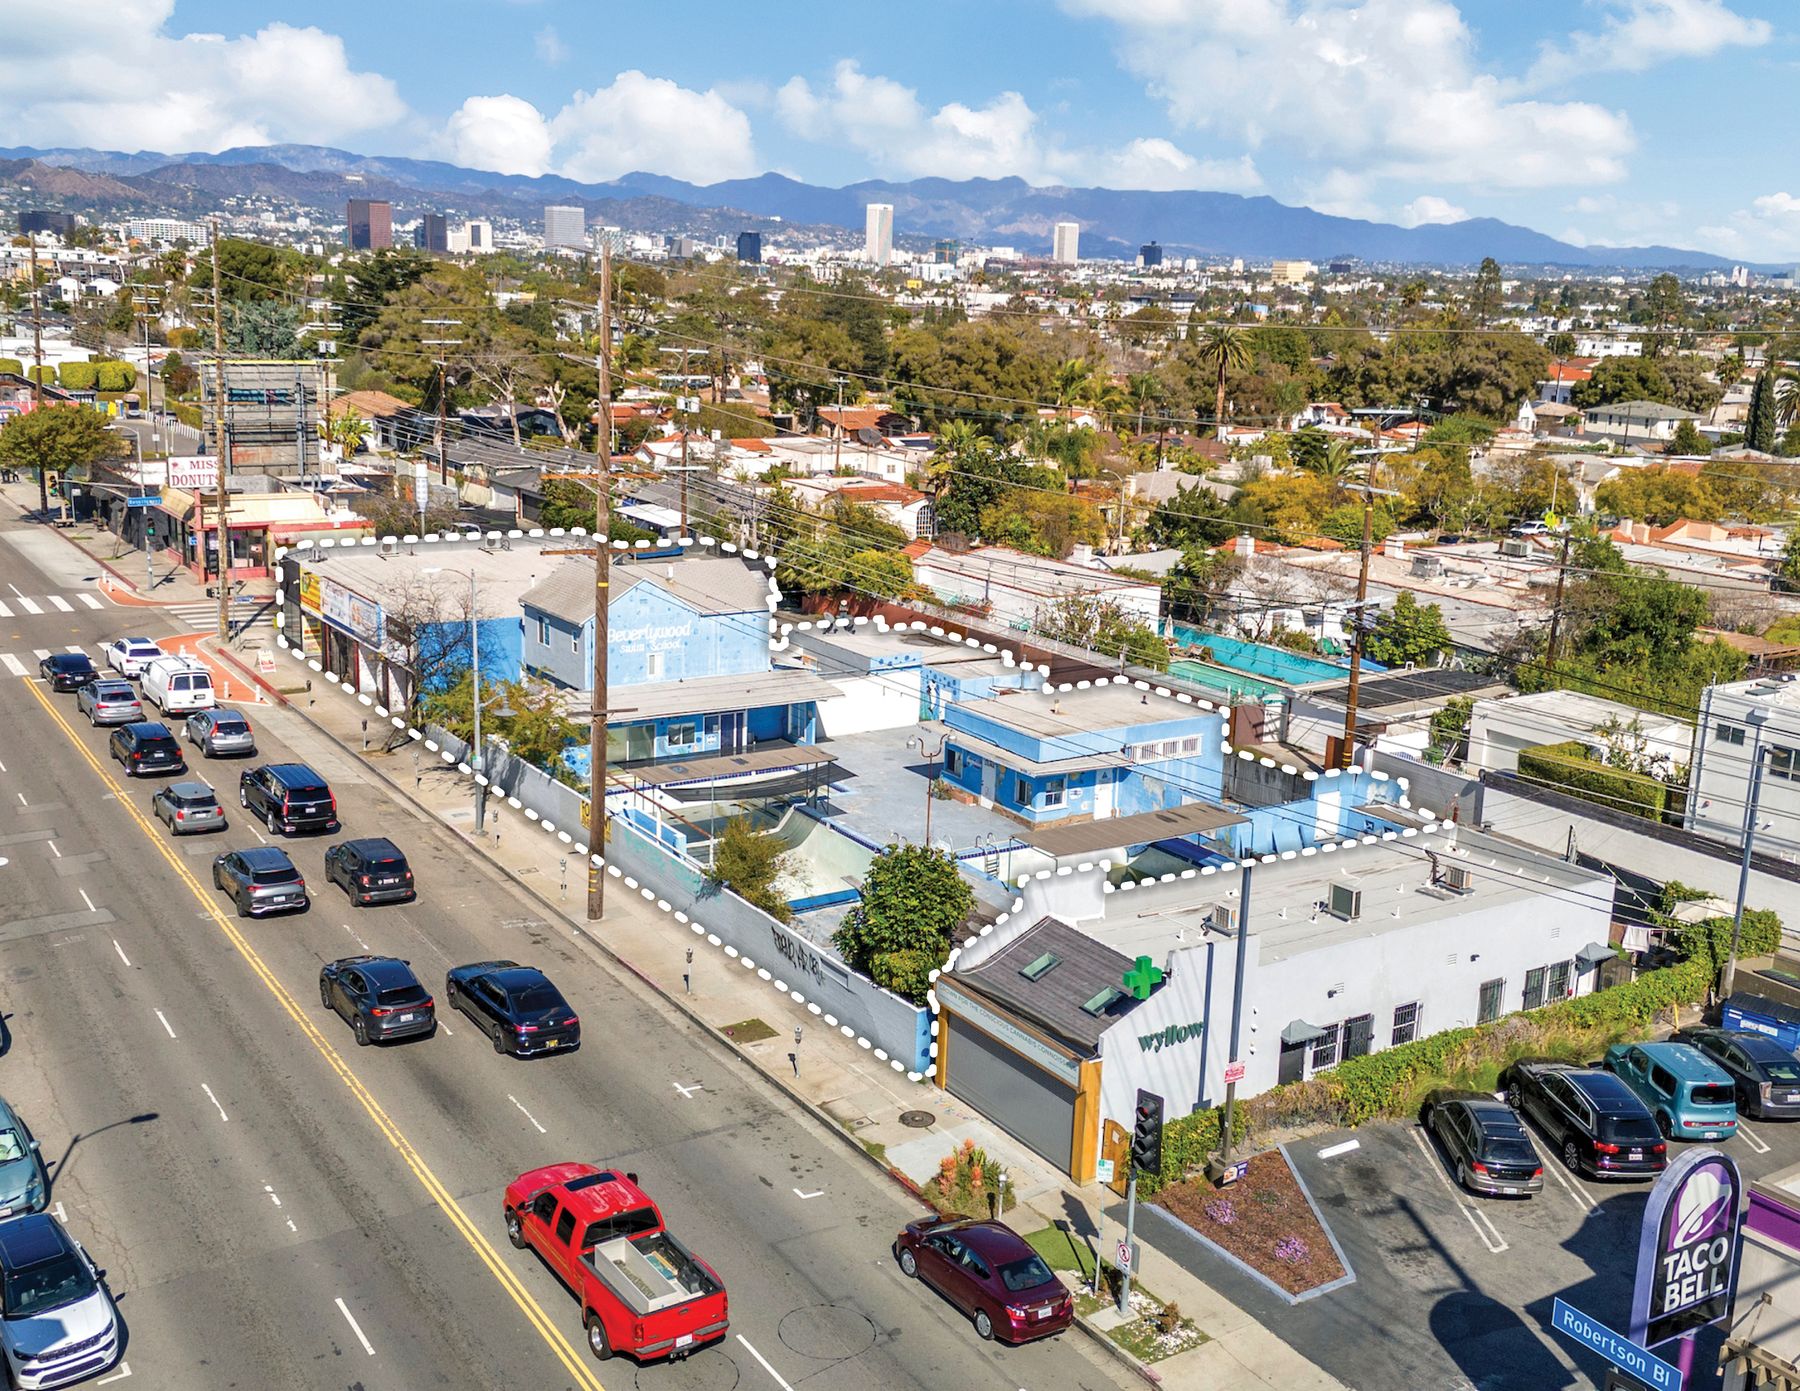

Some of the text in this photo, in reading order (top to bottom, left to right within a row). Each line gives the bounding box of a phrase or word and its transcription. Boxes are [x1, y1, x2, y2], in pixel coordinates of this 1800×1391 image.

[1138, 1021, 1204, 1053] wyllow
[1663, 1236, 1729, 1283] TACO
[1663, 1267, 1724, 1313] BELL
[1563, 1310, 1670, 1386] Robertson Bl
